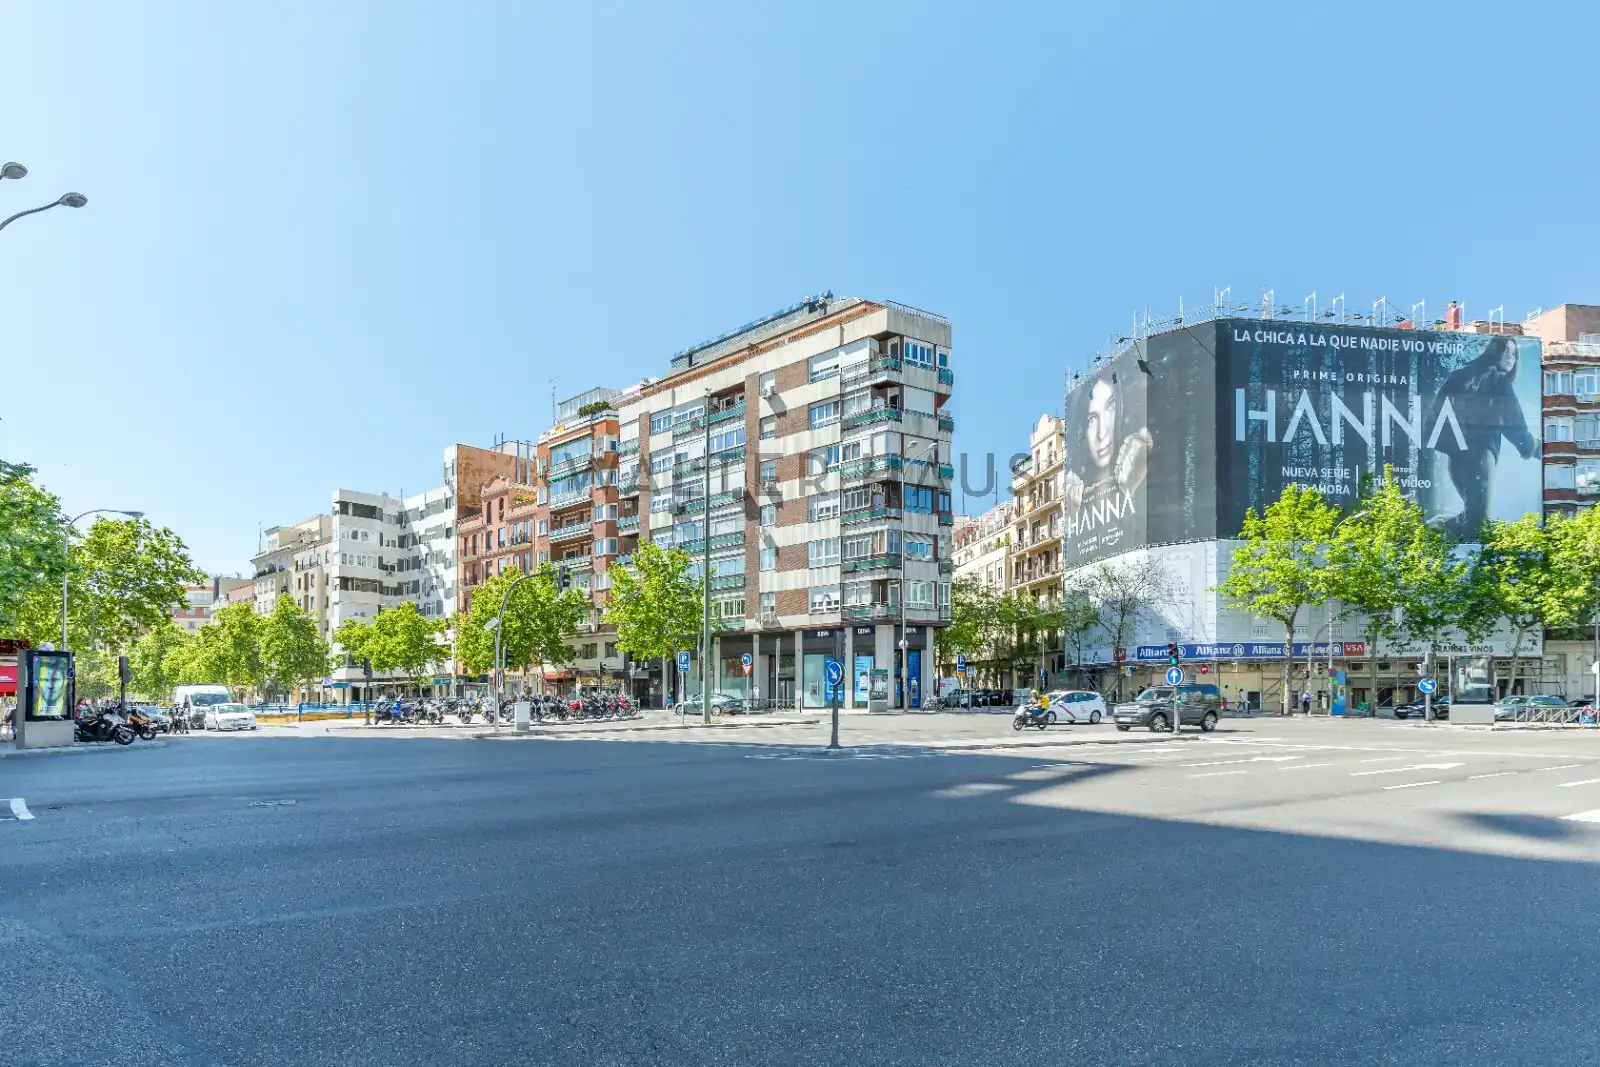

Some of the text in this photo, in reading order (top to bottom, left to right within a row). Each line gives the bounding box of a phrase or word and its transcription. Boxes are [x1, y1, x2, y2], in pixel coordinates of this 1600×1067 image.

[1234, 329, 1465, 355] LA CHICA A LA QUE NADIE VIO VENIR
[1293, 370, 1416, 385] PRIME ORIGINAL
[1235, 388, 1469, 450] HANNA
[1281, 466, 1350, 479] NUEVA SERIE
[1401, 476, 1431, 489] video
[1068, 488, 1136, 538] HANNA
[1195, 645, 1232, 656] Allianz
[1252, 645, 1281, 654] Allianz
[1470, 645, 1493, 653] VINOS
